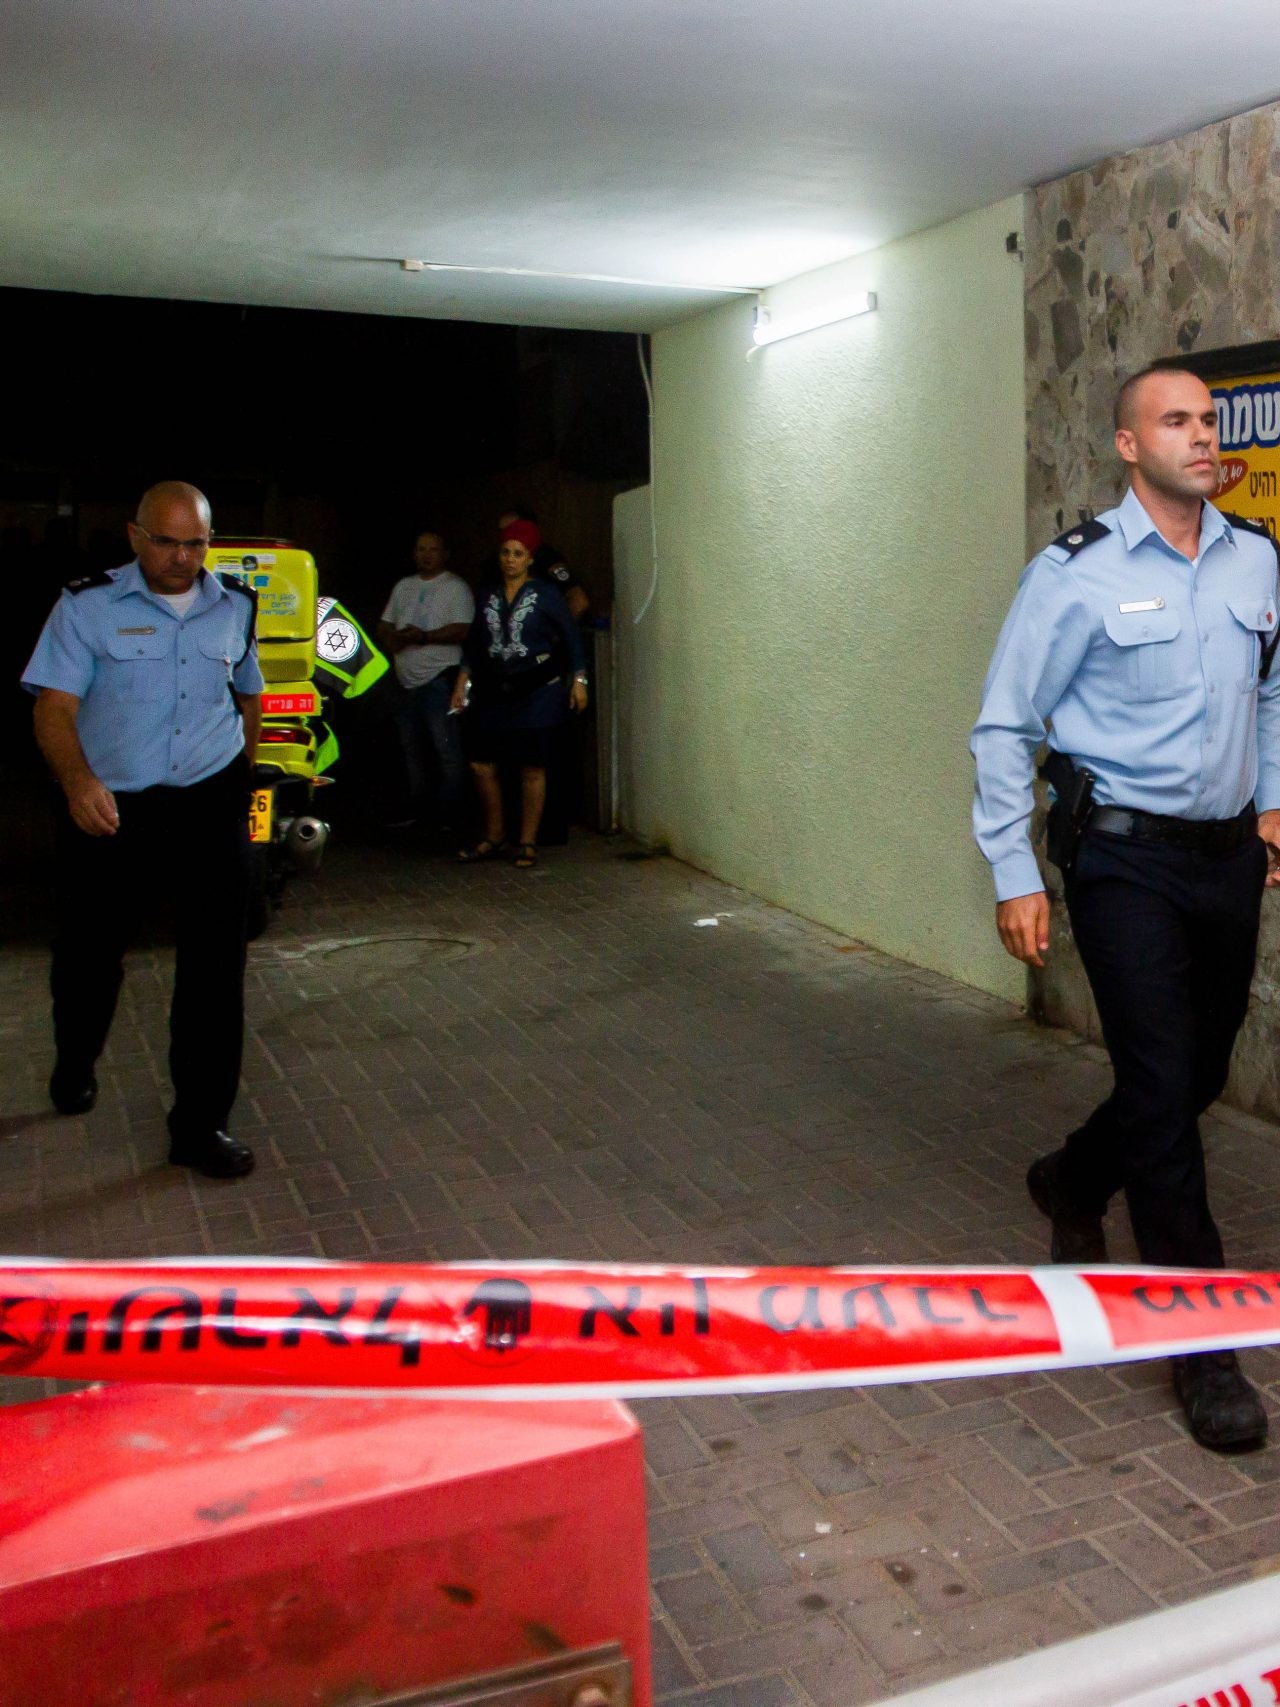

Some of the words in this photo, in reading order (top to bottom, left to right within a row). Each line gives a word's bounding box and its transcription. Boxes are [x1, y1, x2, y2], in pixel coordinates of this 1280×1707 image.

[1250, 470, 1276, 498] רהיט
[62, 1285, 421, 1367] ישראל
[577, 1277, 711, 1339] אין
